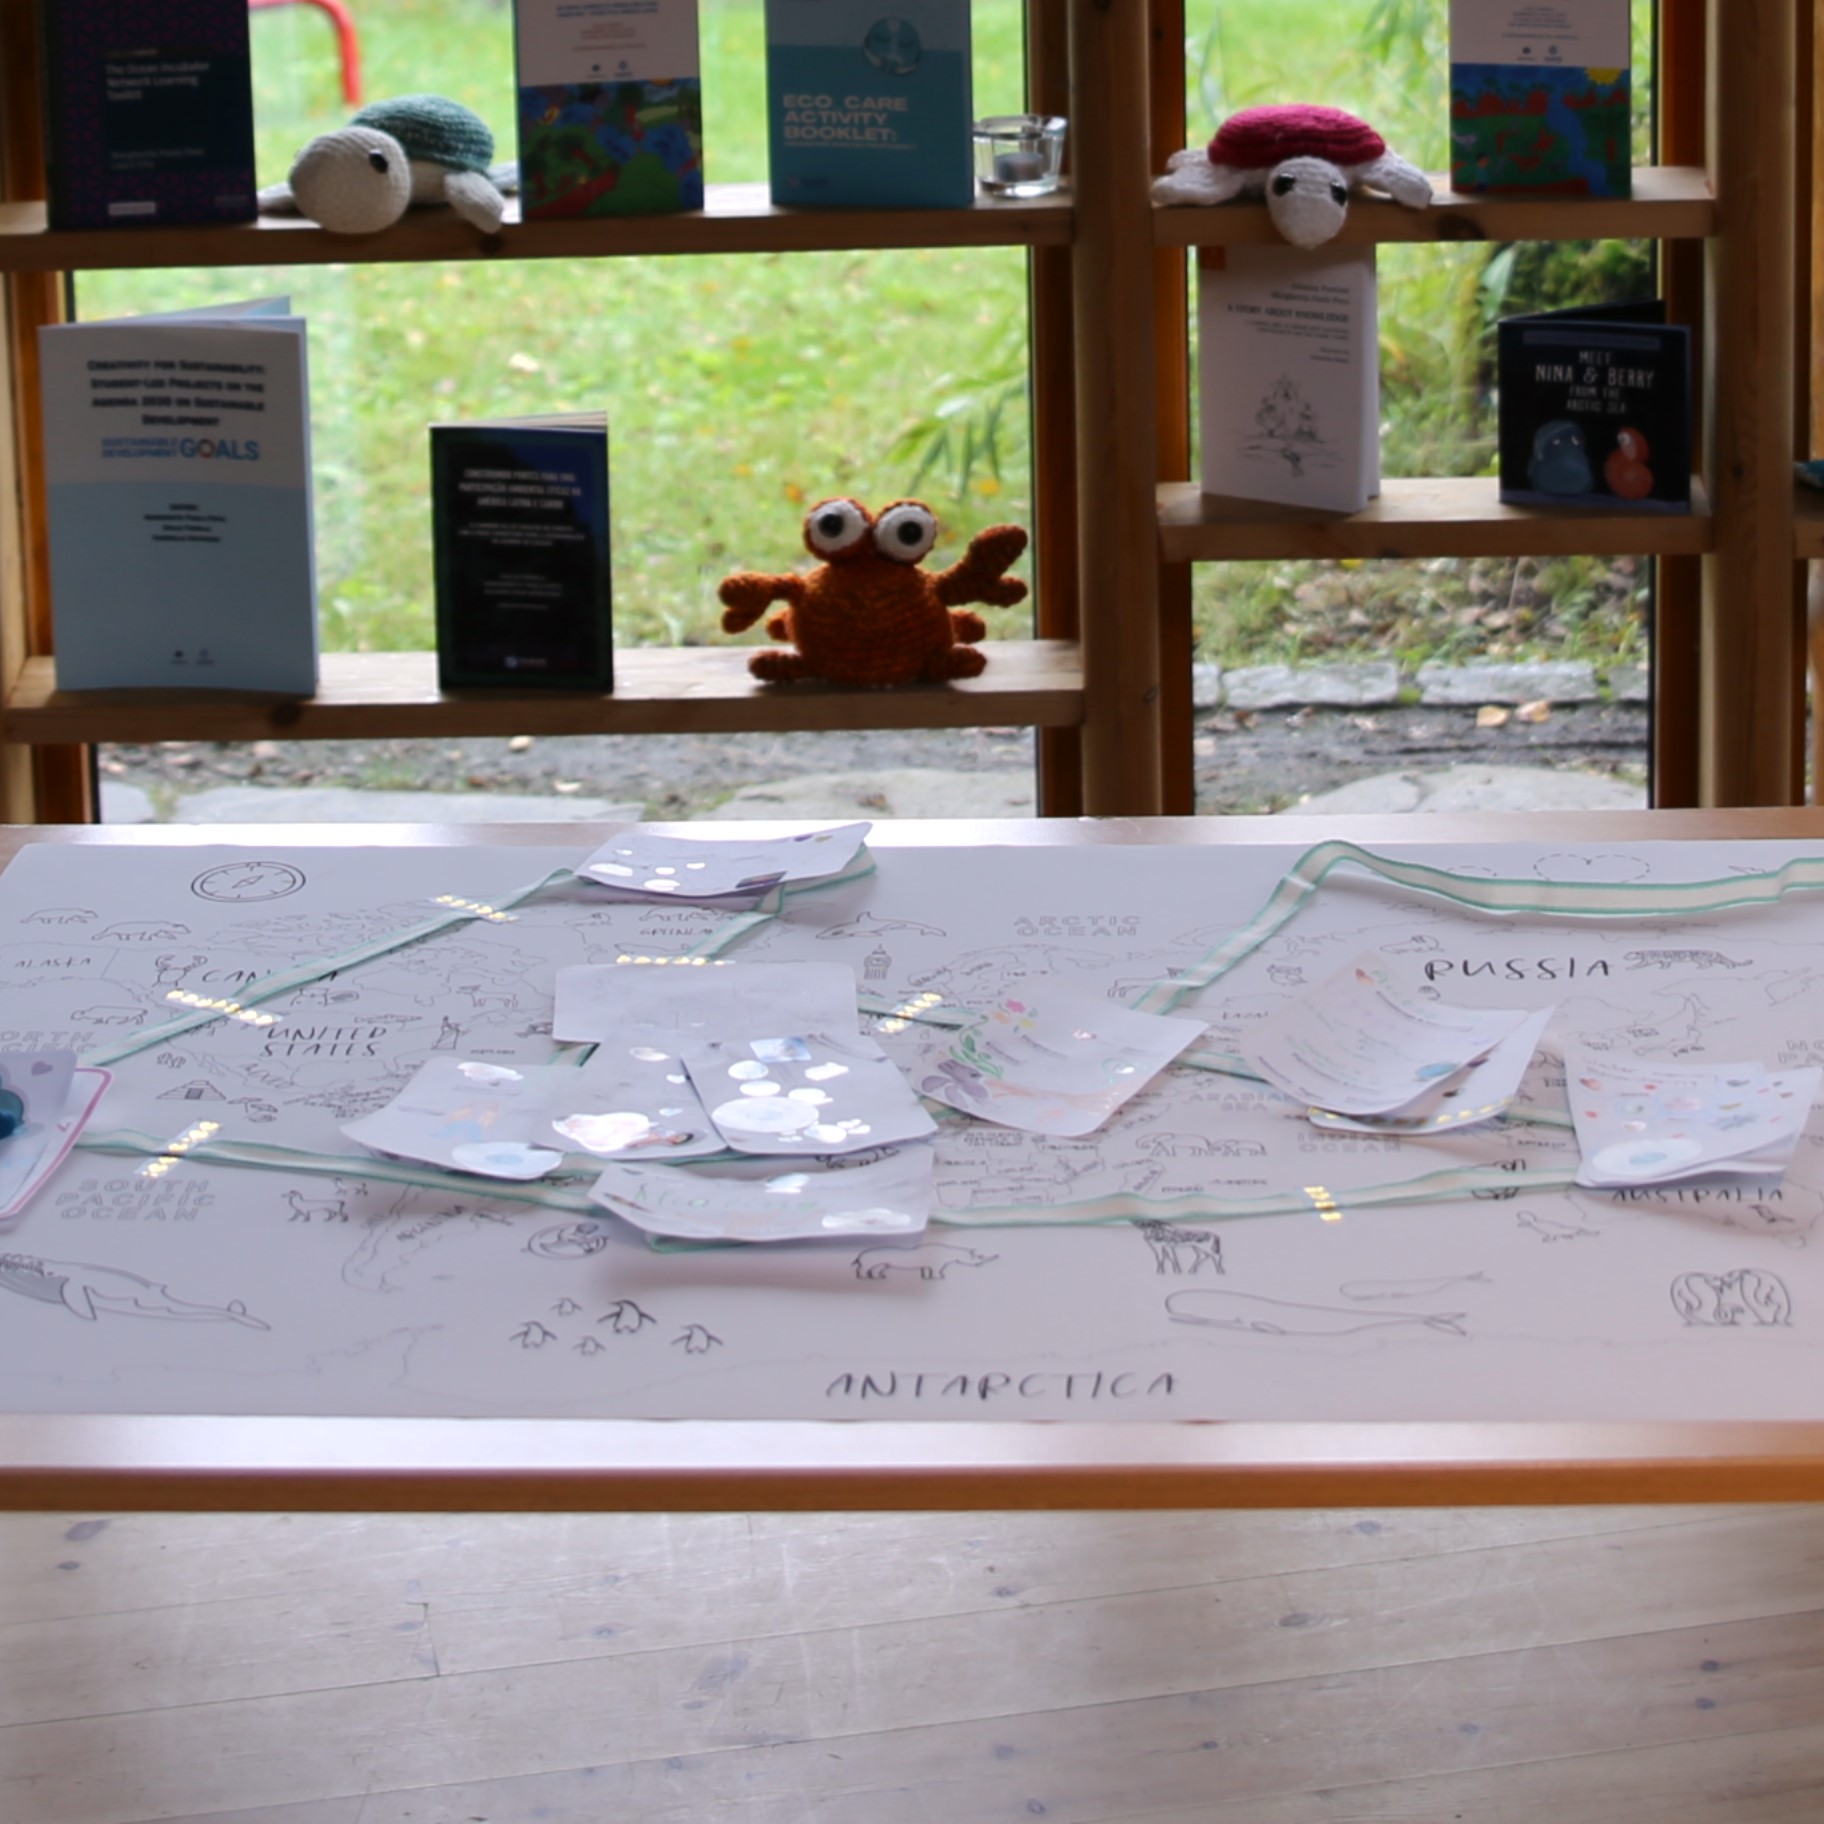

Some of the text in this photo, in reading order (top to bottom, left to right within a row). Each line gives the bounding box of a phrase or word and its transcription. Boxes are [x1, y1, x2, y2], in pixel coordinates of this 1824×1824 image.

[127, 63, 158, 74] Ocean
[784, 110, 889, 125] ACTIVITY
[783, 126, 896, 142] BOOKLET:
[1579, 350, 1611, 365] MEET
[1535, 364, 1655, 389] NINA & BERRY
[1569, 385, 1621, 400] FROM THE
[1565, 398, 1627, 414] ARCTIC SEA
[180, 438, 259, 460] GOALS
[1013, 915, 1142, 927] ARCTIC
[1016, 925, 1138, 937] OCEAN
[1423, 956, 1615, 981] RUSSIA
[266, 1026, 388, 1041] UNITED
[259, 1042, 381, 1057] STATES
[1298, 1142, 1403, 1154] OCEAN
[77, 1179, 210, 1193] SOUTH
[54, 1192, 217, 1208] PACIFIC
[1611, 1188, 1783, 1203] AUSTRALIA
[60, 1206, 200, 1222] OCEAN
[826, 1371, 1176, 1400] ANTARCTICA
